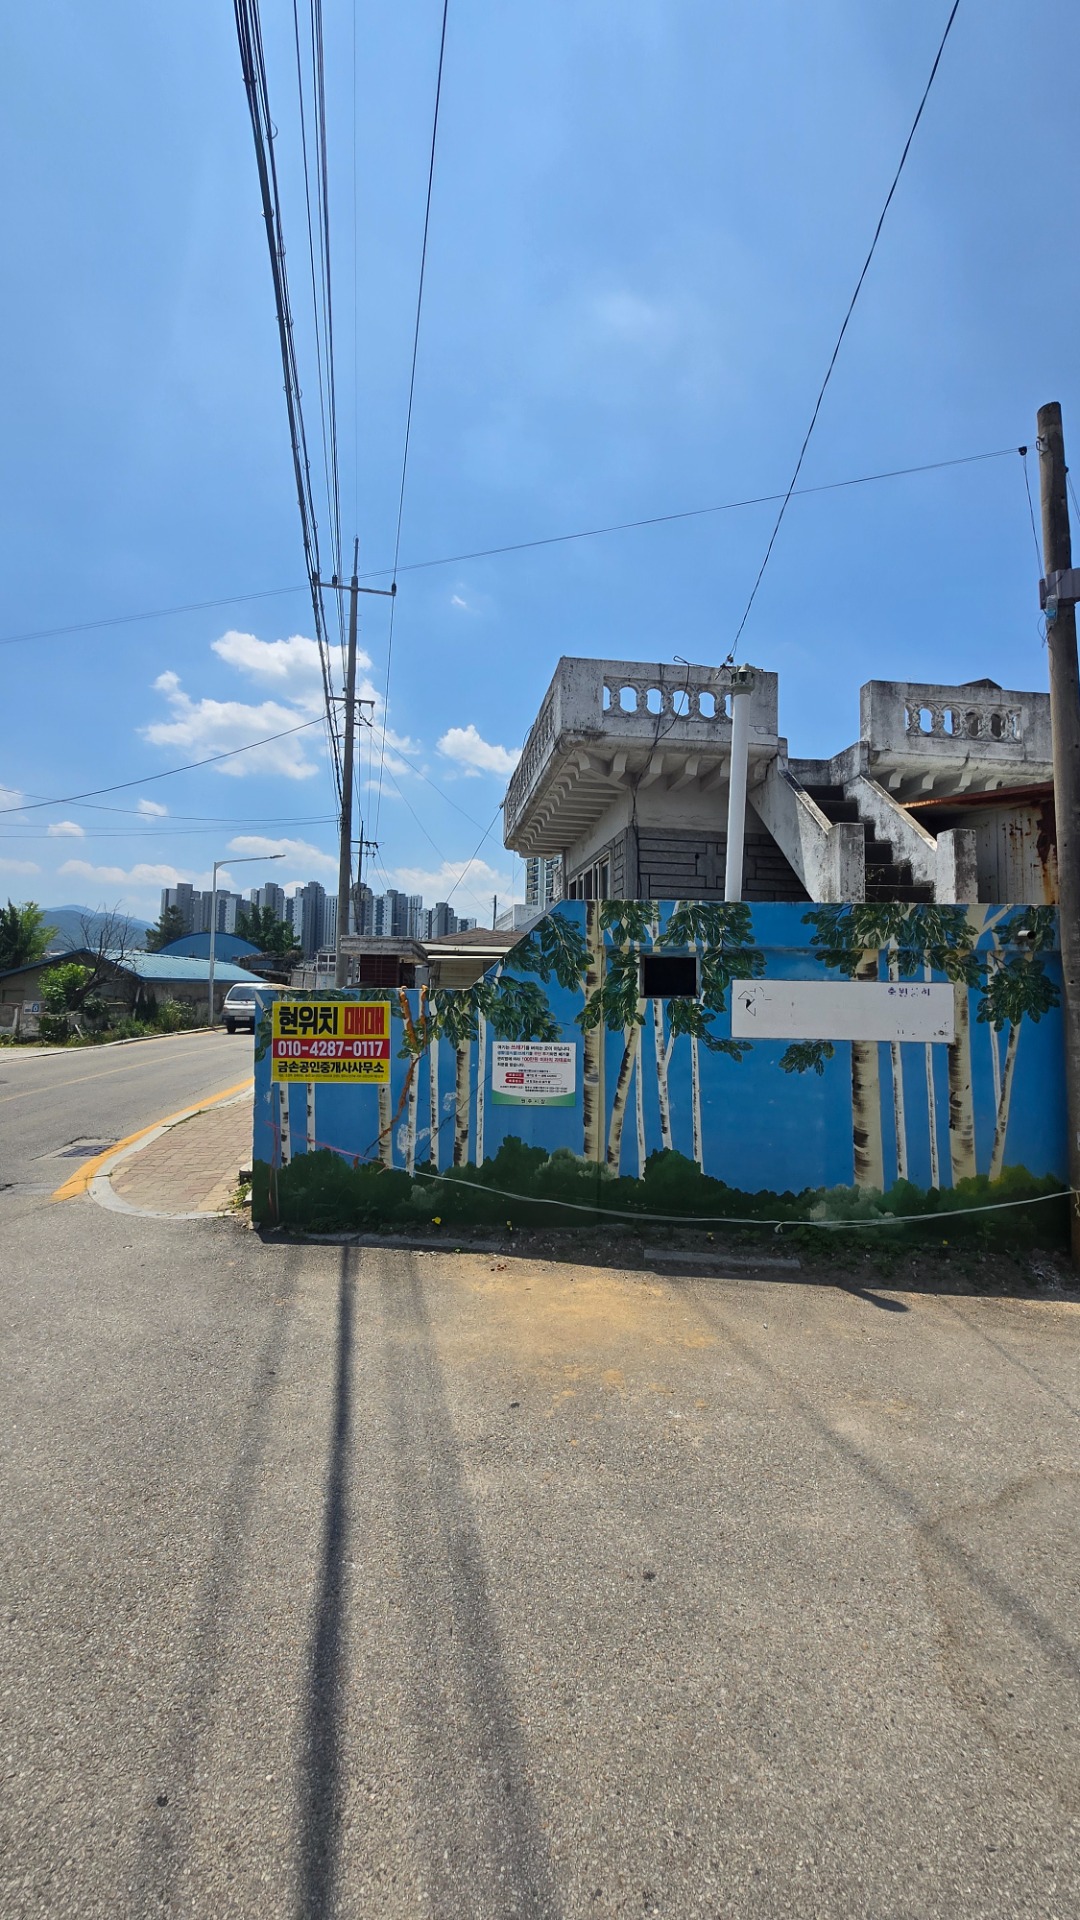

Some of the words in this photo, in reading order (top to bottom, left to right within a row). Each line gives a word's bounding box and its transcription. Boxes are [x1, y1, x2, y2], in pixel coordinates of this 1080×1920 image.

[279, 1006, 338, 1035] 현위치
[344, 1006, 385, 1035] 매매
[278, 1040, 384, 1057] 010-4287-0117
[278, 1060, 385, 1074] 금손공인중개사사무소
